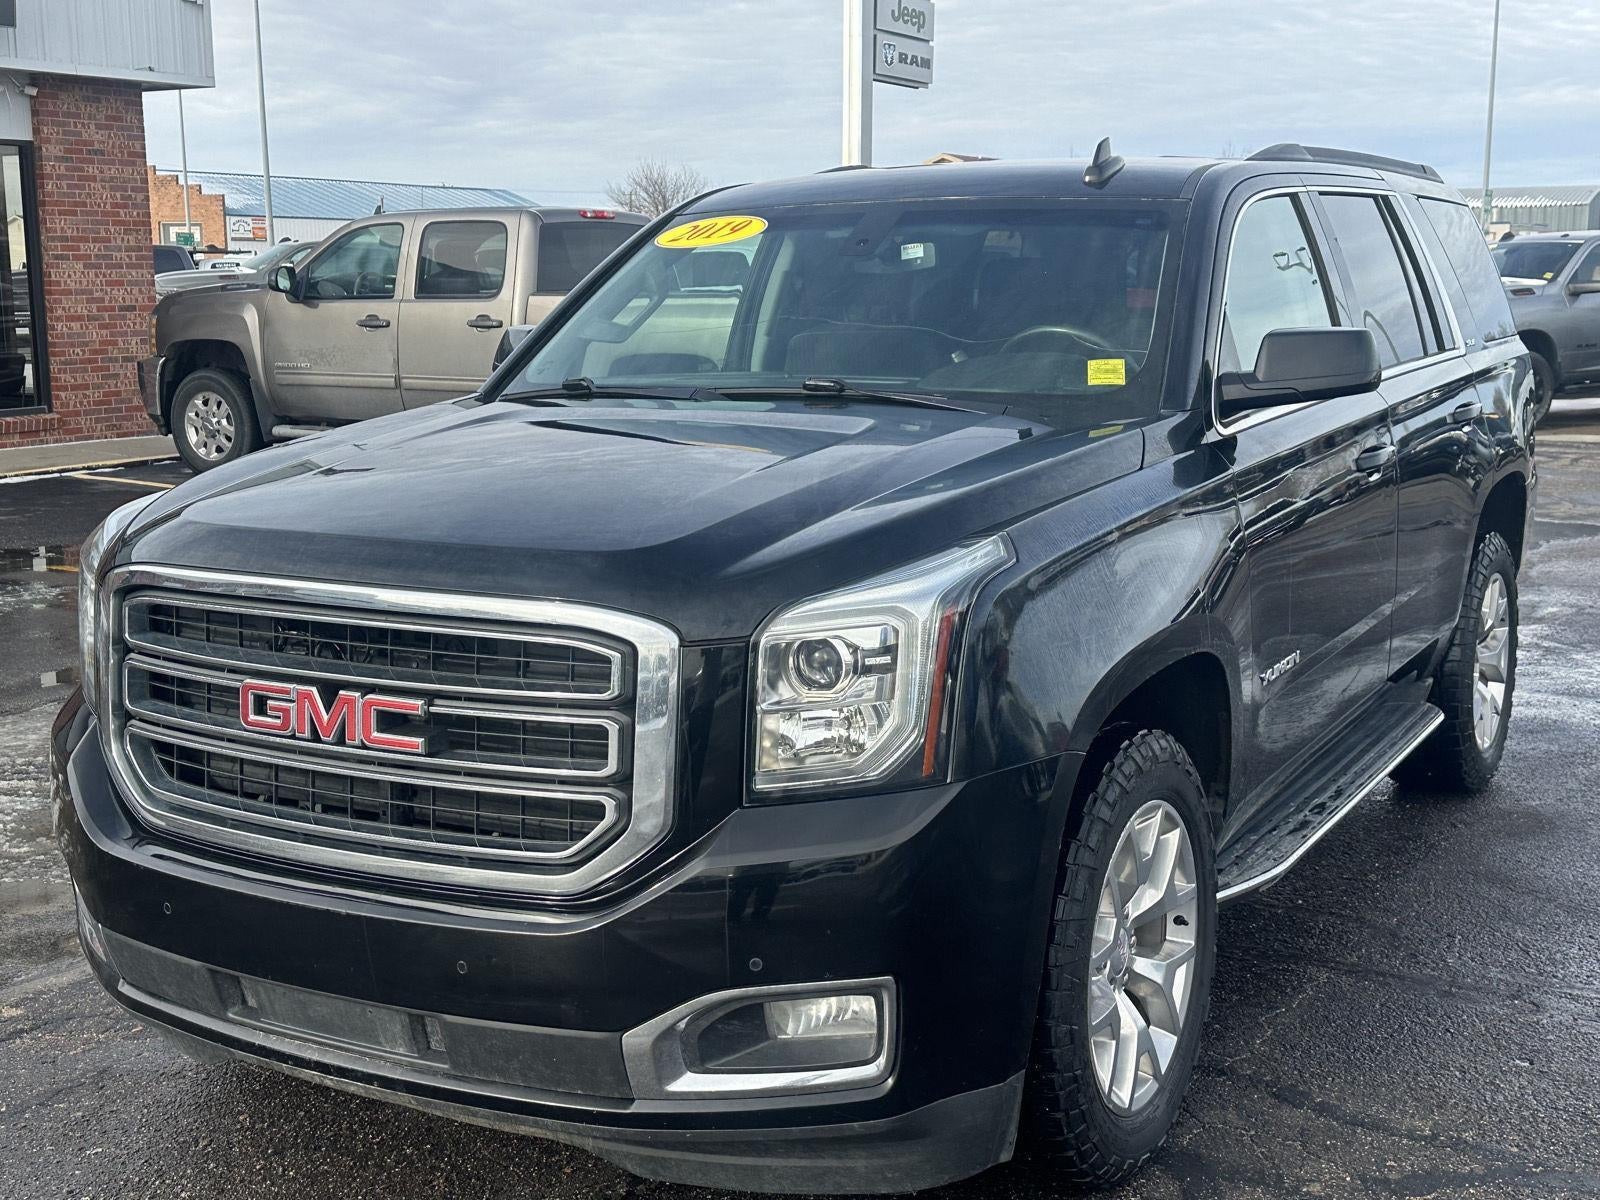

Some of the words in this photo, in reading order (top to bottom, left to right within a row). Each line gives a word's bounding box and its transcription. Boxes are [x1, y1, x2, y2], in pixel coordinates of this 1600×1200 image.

[891, 0, 926, 33] Jeep
[898, 51, 931, 70] RAM
[666, 219, 753, 243] 2019
[1259, 650, 1300, 686] YUKON
[239, 678, 426, 755] GMC
